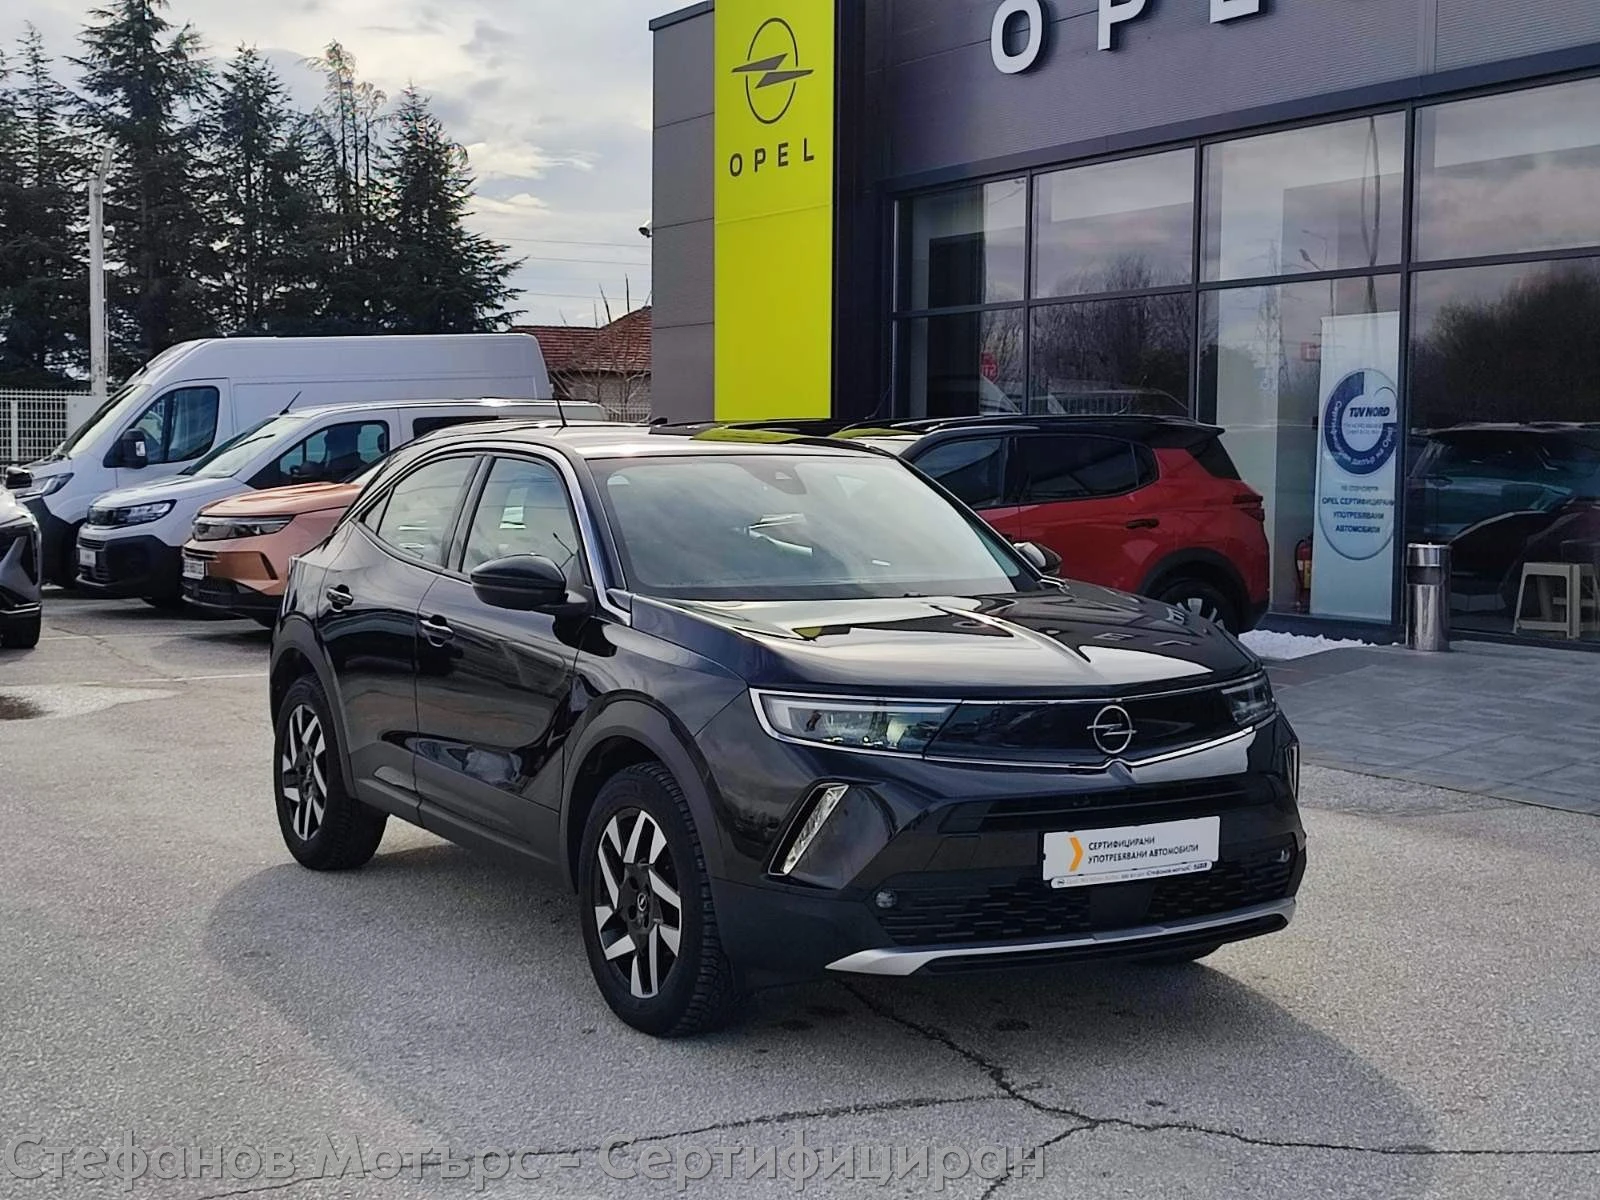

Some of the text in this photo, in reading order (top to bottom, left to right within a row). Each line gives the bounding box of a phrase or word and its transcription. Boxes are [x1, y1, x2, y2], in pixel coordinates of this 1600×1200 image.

[729, 137, 815, 177] OPEL
[1366, 406, 1390, 417] NORD
[1088, 836, 1155, 851] СЕРТИФИЦИРАНИ
[1088, 843, 1199, 864] УПОТРЕБЯВАНИ АВТОМОБИЛИ
